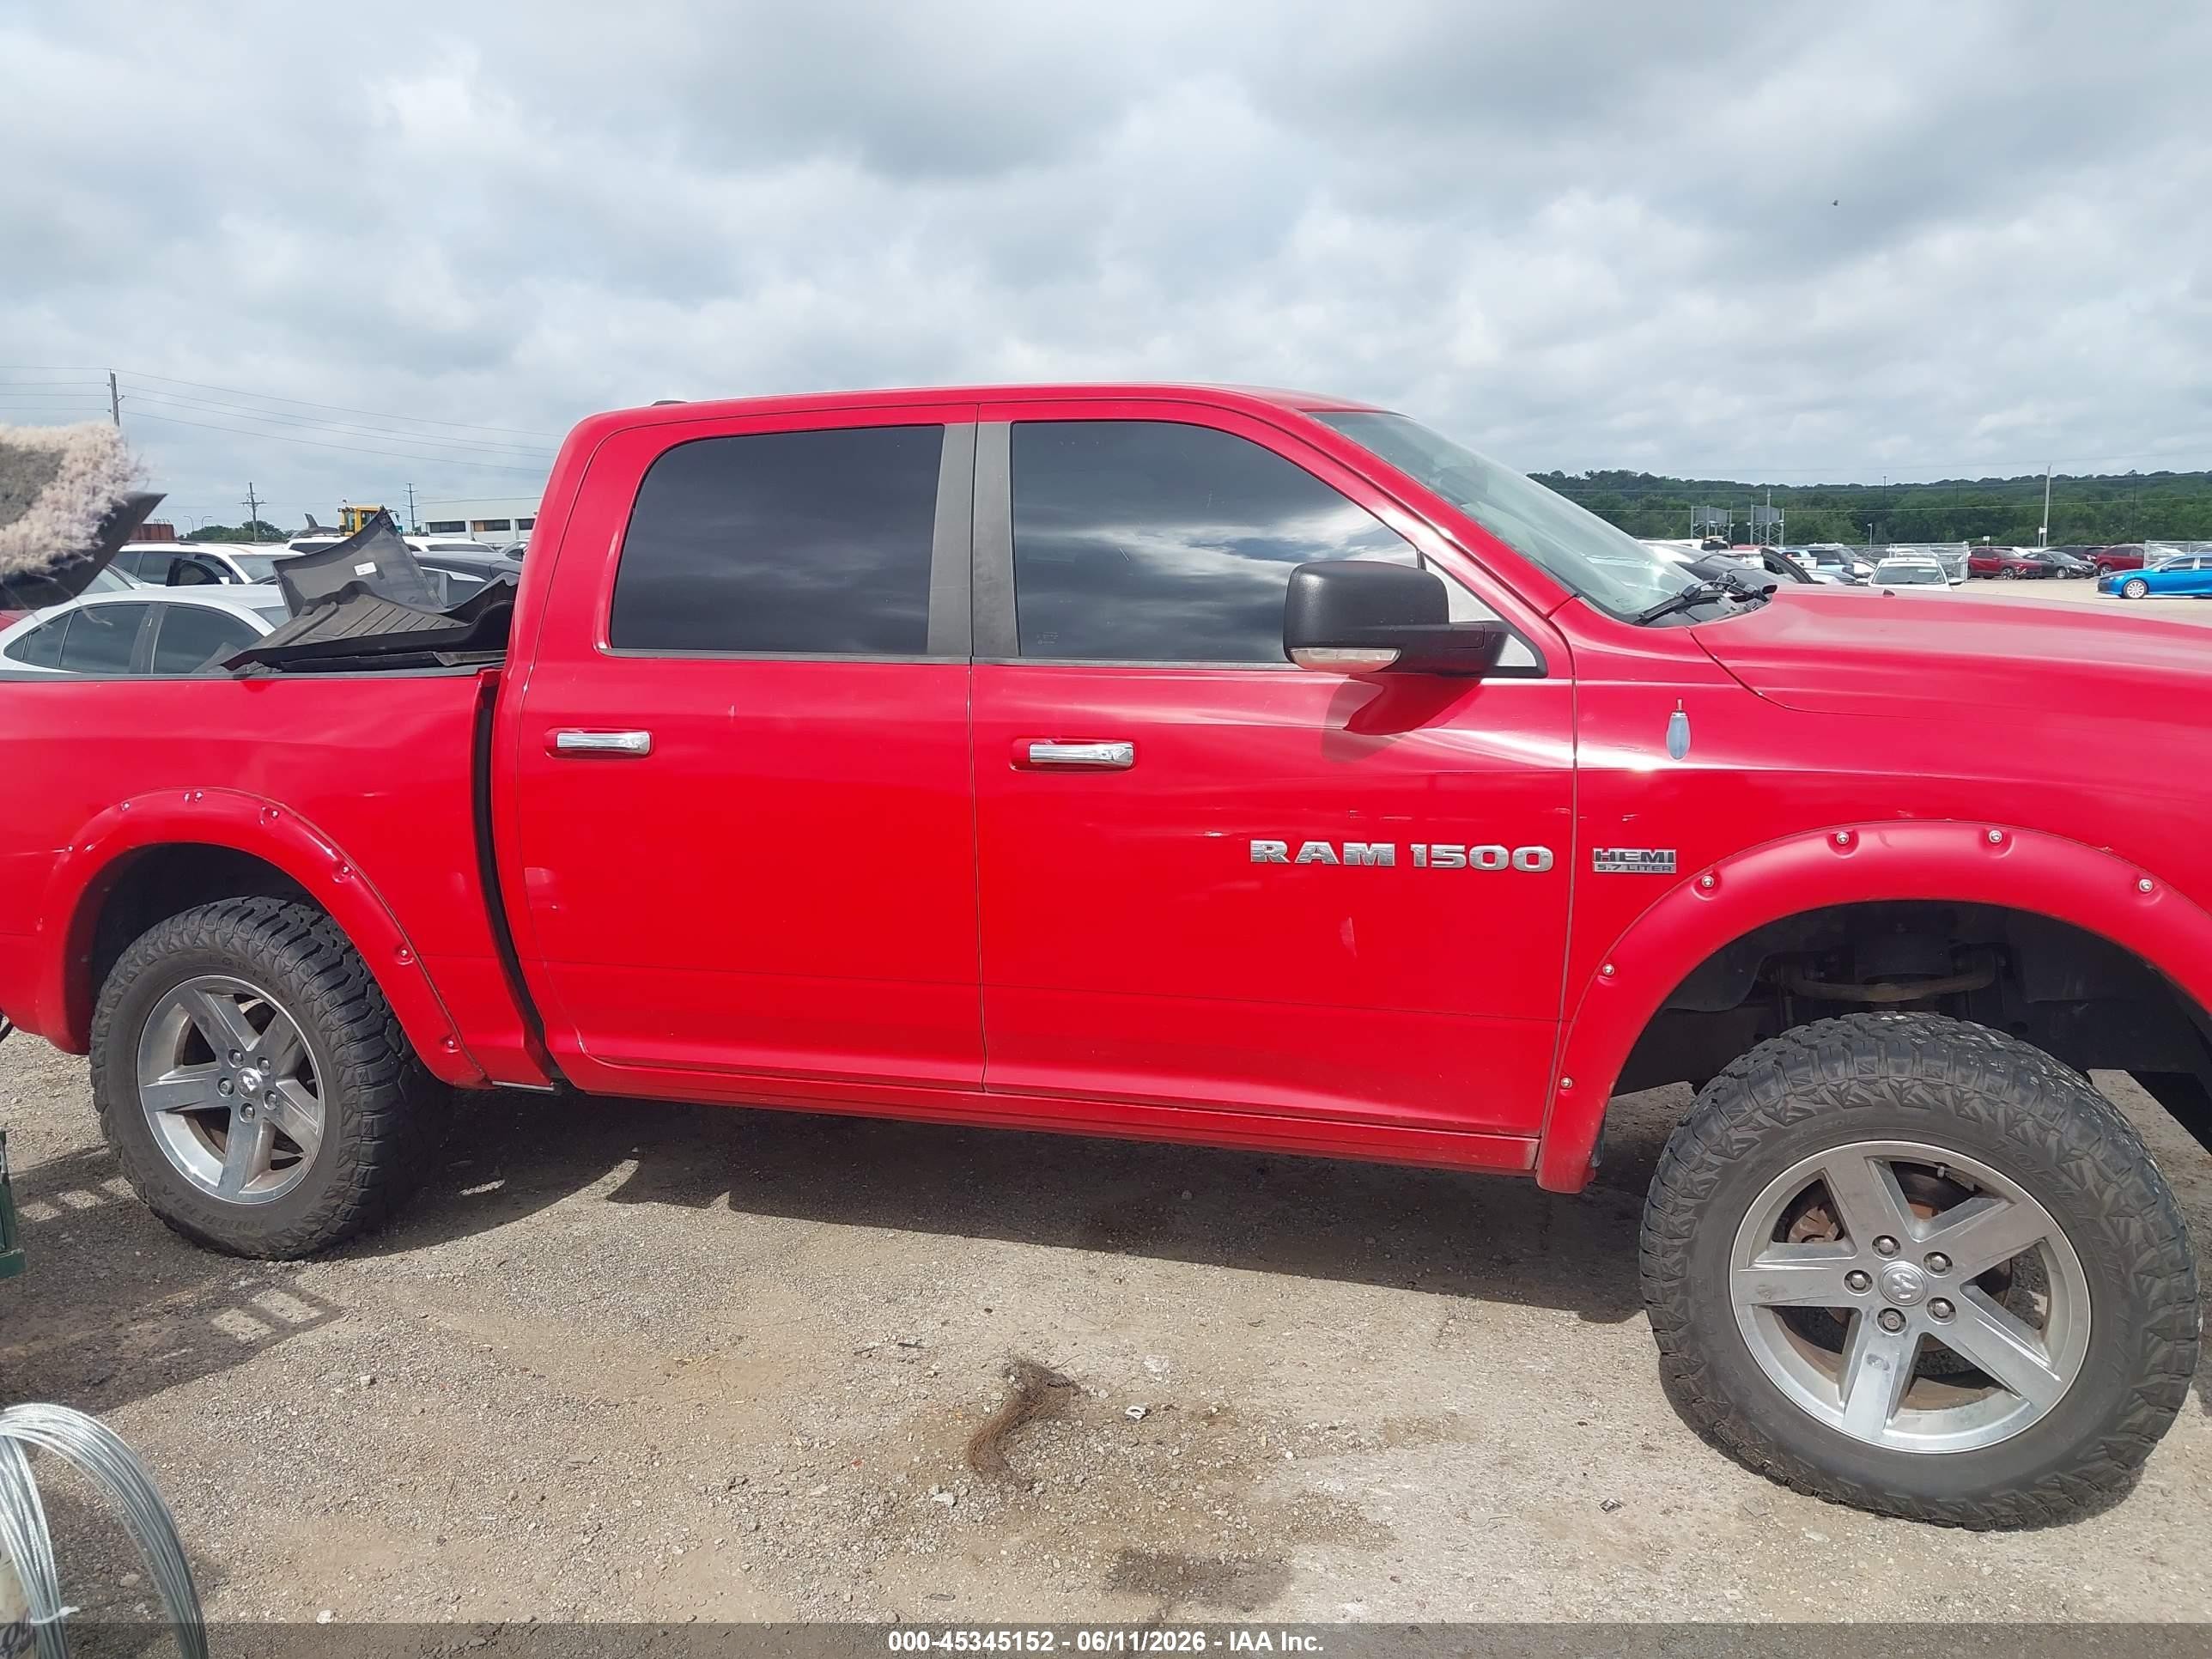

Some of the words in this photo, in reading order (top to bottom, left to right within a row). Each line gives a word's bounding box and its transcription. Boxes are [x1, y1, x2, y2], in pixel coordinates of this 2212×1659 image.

[1250, 840, 1395, 866] RAM
[1410, 843, 1553, 872] 1500
[1594, 848, 1675, 864] HEMI
